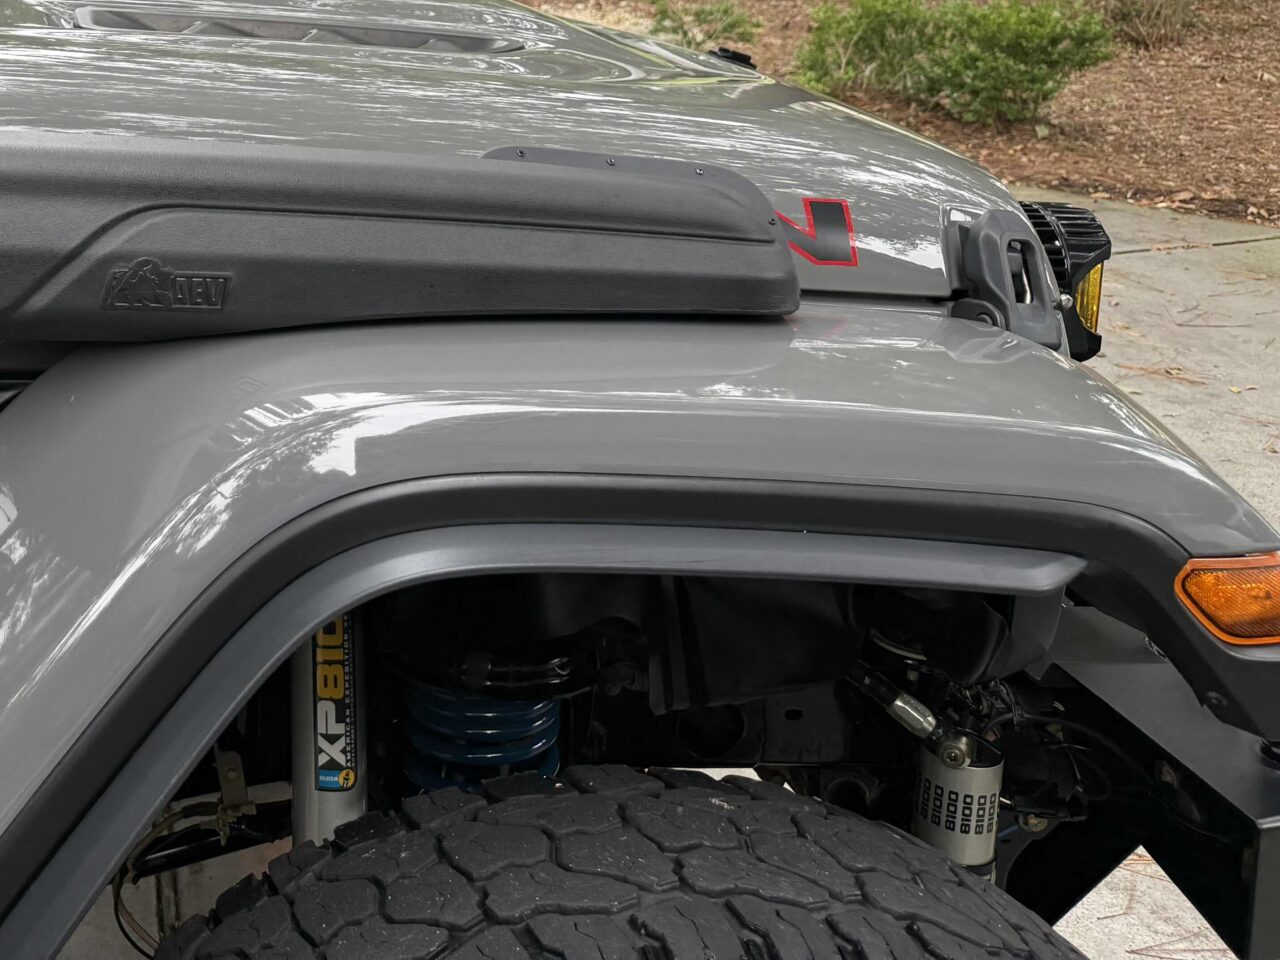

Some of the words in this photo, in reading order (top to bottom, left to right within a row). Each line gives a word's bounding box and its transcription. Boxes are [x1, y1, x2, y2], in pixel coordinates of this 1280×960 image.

[175, 276, 226, 305] AEV
[931, 784, 944, 826] 8100
[945, 790, 959, 831] 8100
[960, 794, 974, 834] 8100
[974, 795, 987, 834] 8100
[987, 792, 997, 834] 8100
